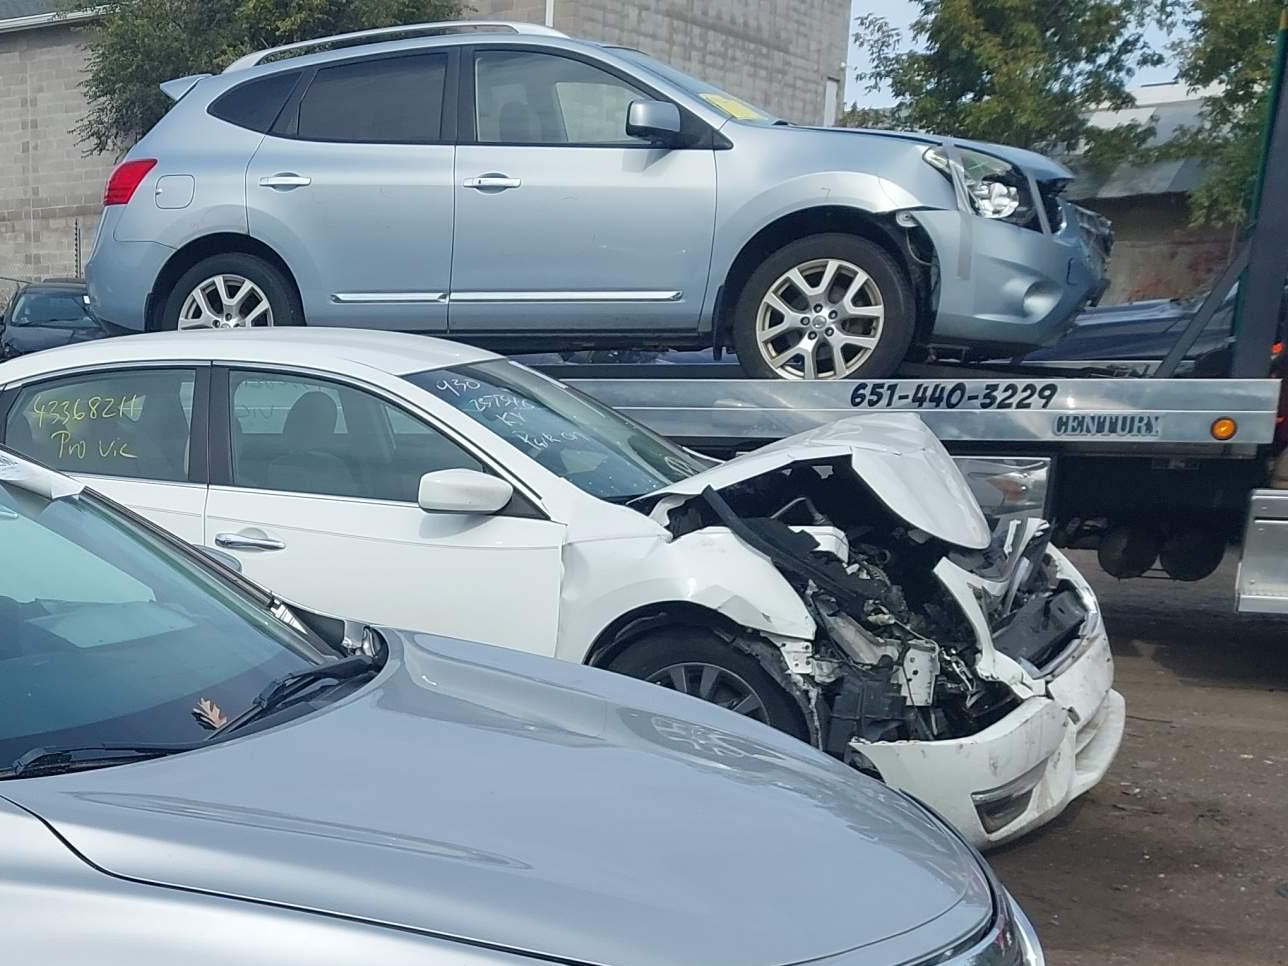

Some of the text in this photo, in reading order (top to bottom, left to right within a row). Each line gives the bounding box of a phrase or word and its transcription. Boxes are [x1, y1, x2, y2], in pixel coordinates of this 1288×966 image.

[850, 382, 1059, 410] 651-440-3229
[1053, 413, 1162, 437] CENTURY
[50, 430, 87, 460] Pro
